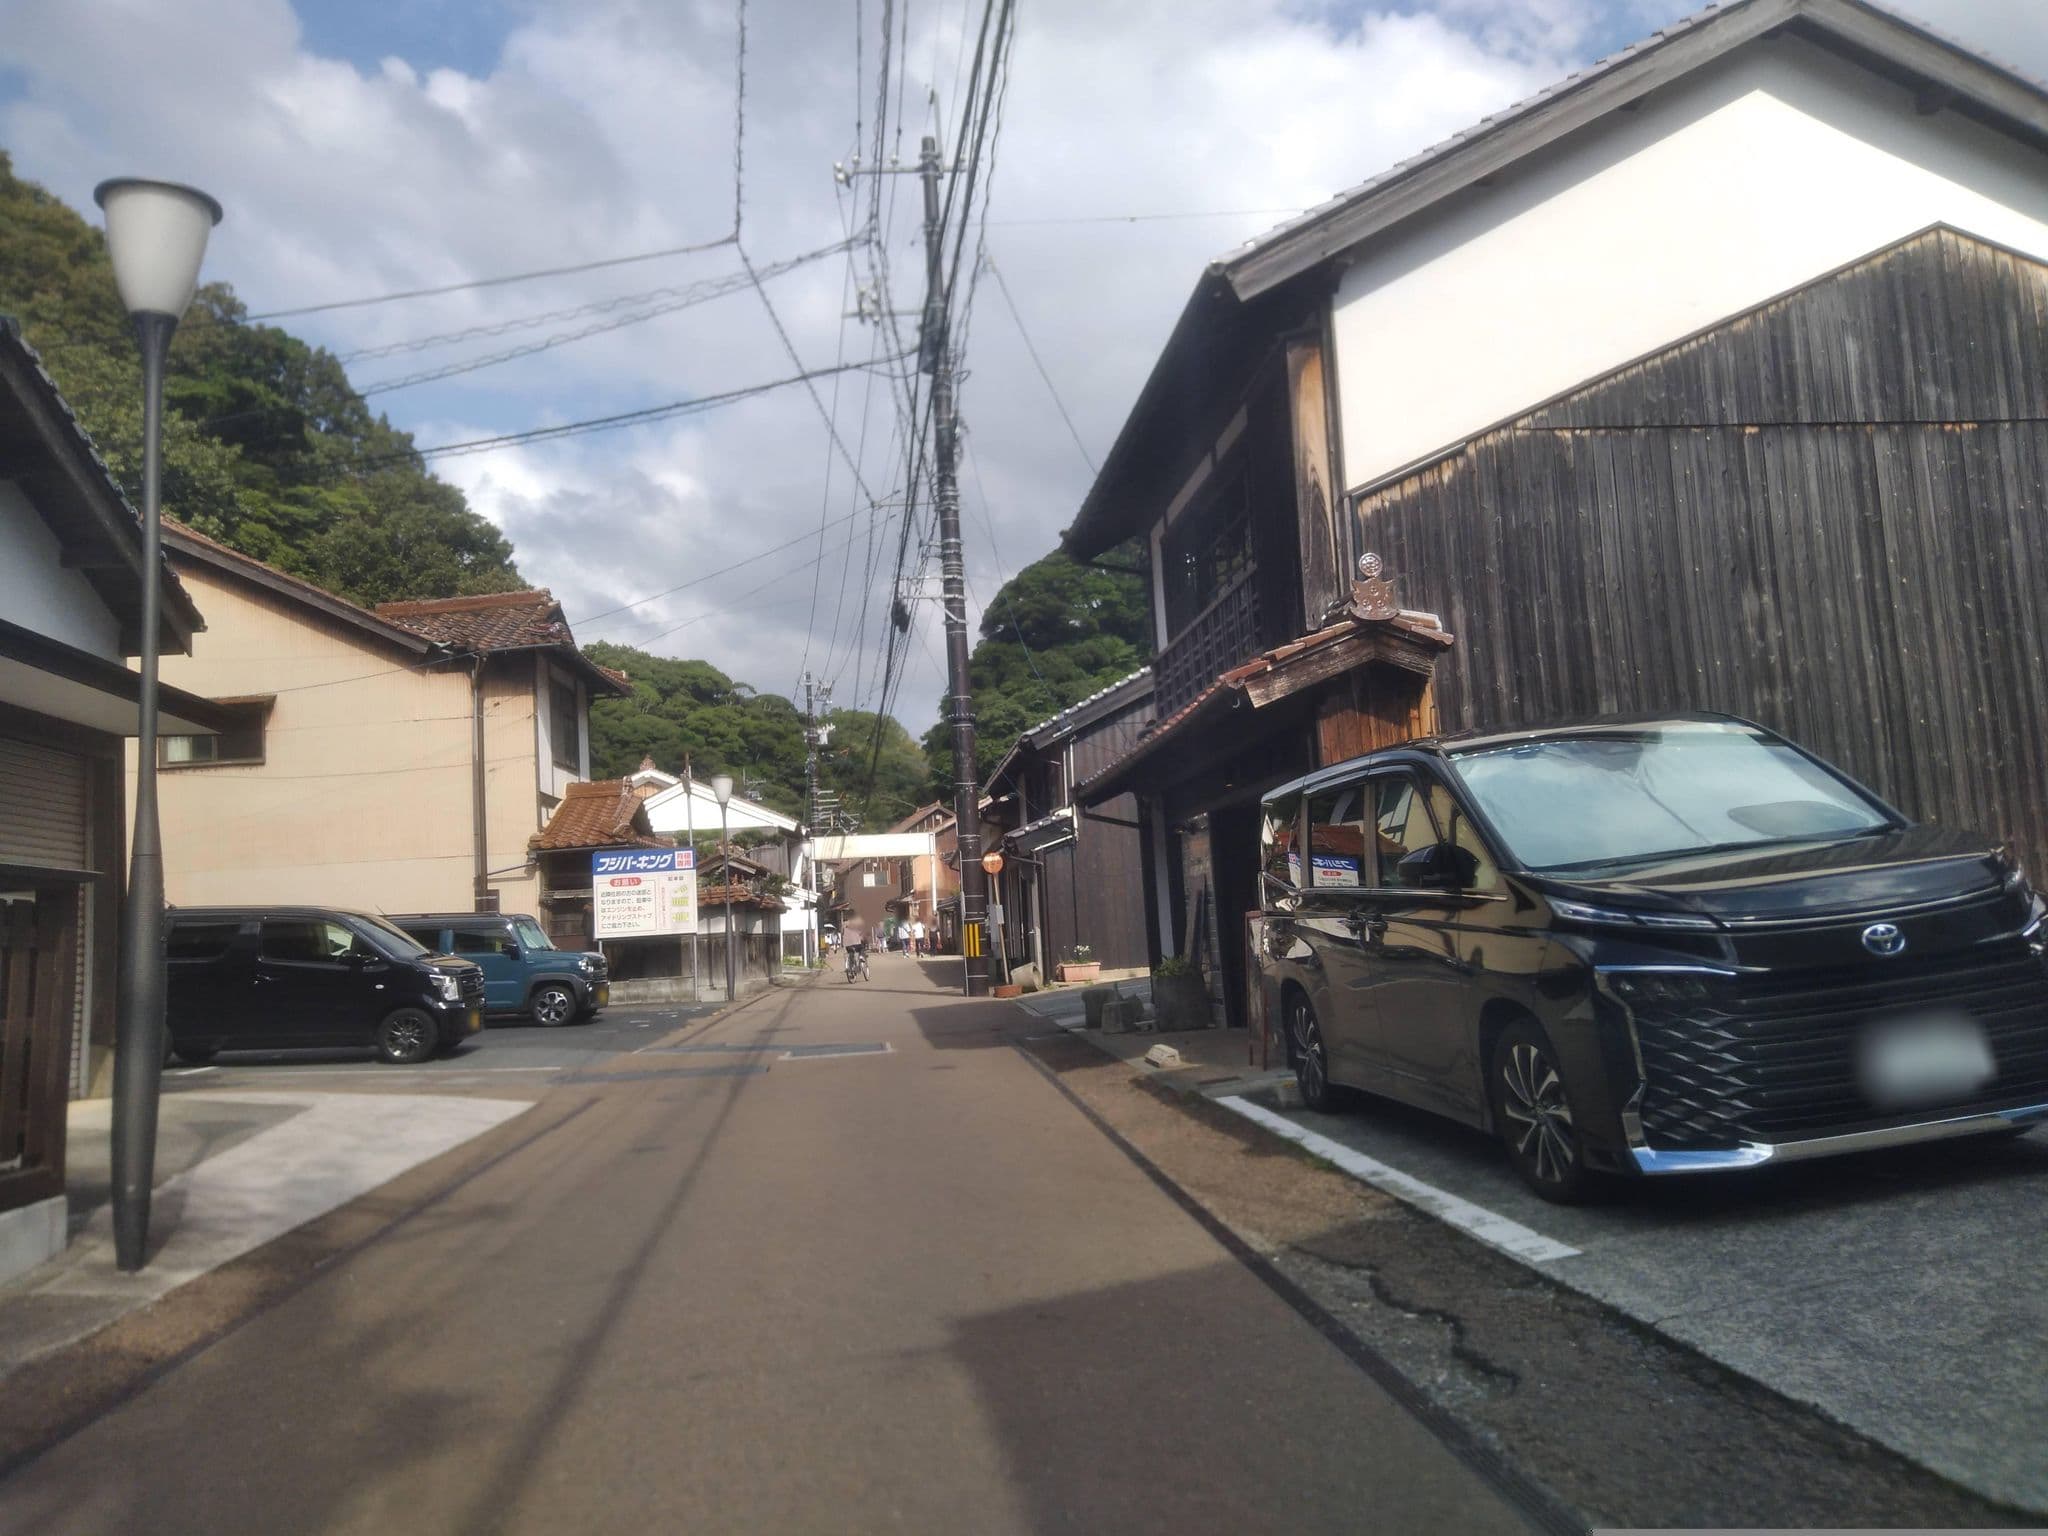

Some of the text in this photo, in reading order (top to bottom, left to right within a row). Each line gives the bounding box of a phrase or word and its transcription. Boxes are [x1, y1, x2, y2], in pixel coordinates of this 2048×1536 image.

[597, 854, 673, 872] フジパーキング
